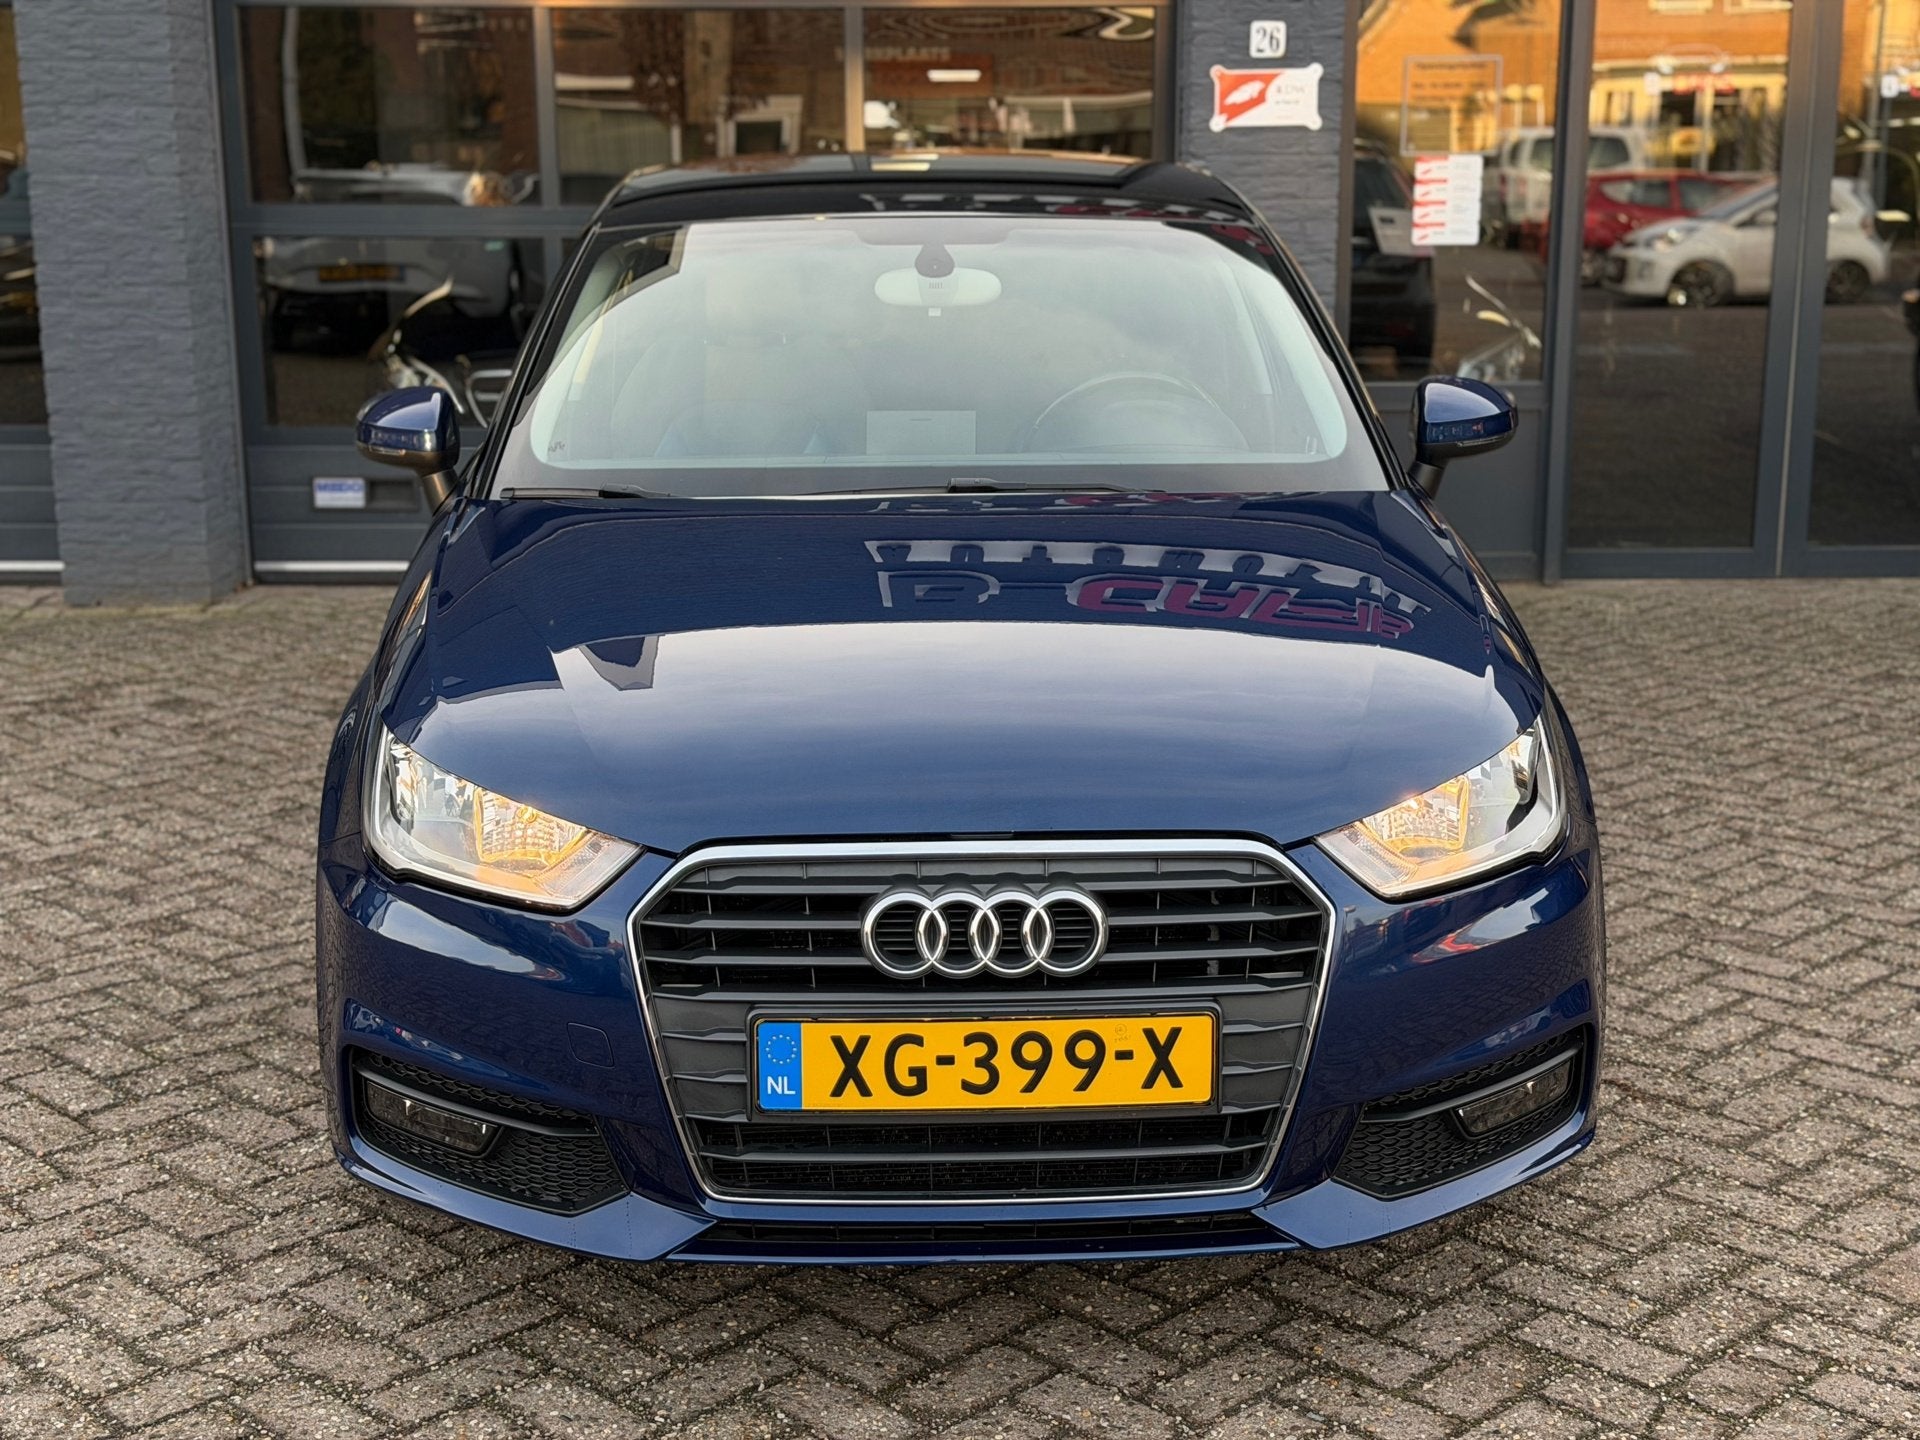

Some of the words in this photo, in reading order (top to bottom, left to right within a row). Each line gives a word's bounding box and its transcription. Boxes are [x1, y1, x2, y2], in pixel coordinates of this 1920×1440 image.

[1256, 26, 1281, 53] 26
[829, 1026, 1184, 1098] XG-399-X
[766, 1076, 796, 1095] NL
